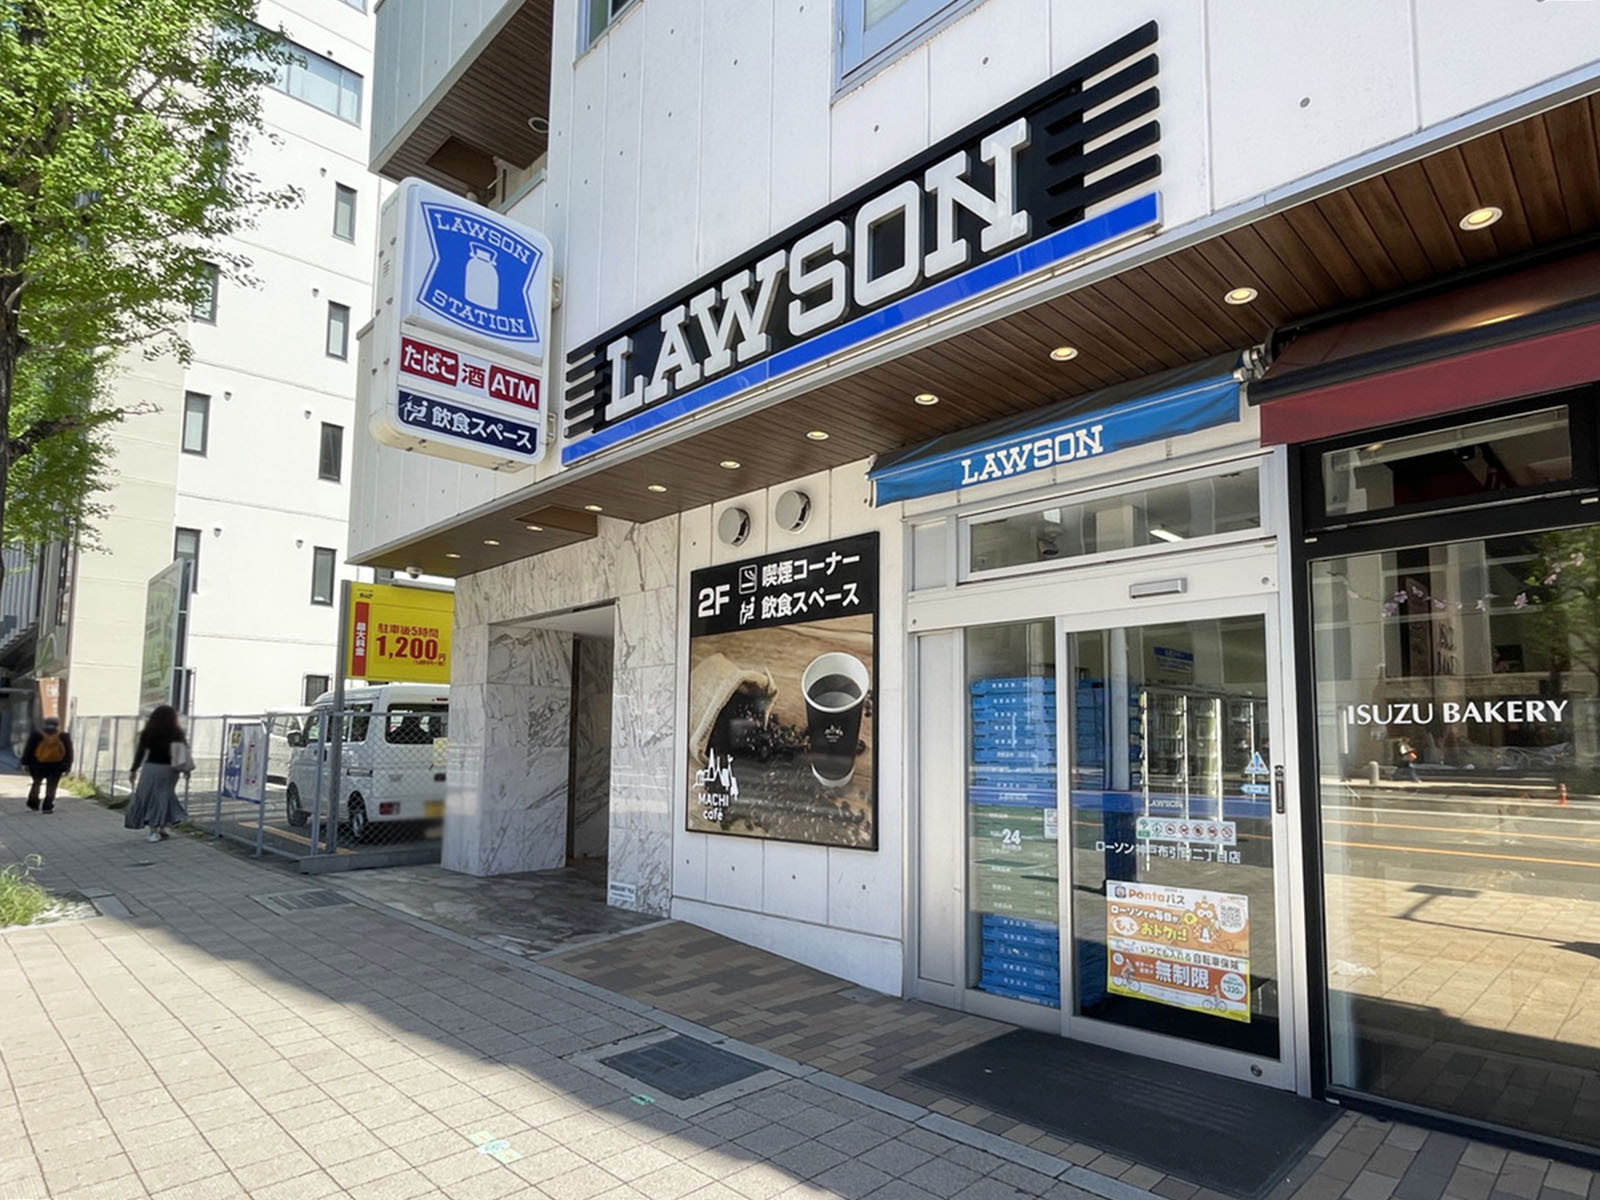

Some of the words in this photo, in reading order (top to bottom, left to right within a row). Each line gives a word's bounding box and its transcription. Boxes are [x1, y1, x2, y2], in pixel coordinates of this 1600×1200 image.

[434, 213, 532, 265] LAWSON
[605, 117, 1030, 421] LAWSON
[432, 289, 527, 334] STATION
[403, 345, 457, 379] たばこ
[461, 364, 485, 388] 酒
[491, 373, 536, 403] ATM
[432, 406, 532, 449] 飲食スペース
[961, 425, 1103, 485] LAWSON
[762, 551, 860, 587] 喫煙コーナー
[698, 584, 730, 618] 2F
[761, 583, 859, 619] 飲食スペース
[1348, 702, 1434, 725] ISUZU
[1443, 700, 1568, 724] BAKERY
[698, 792, 730, 807] MACHI
[1002, 828, 1021, 845] 24
[1156, 960, 1210, 989] 無制限
